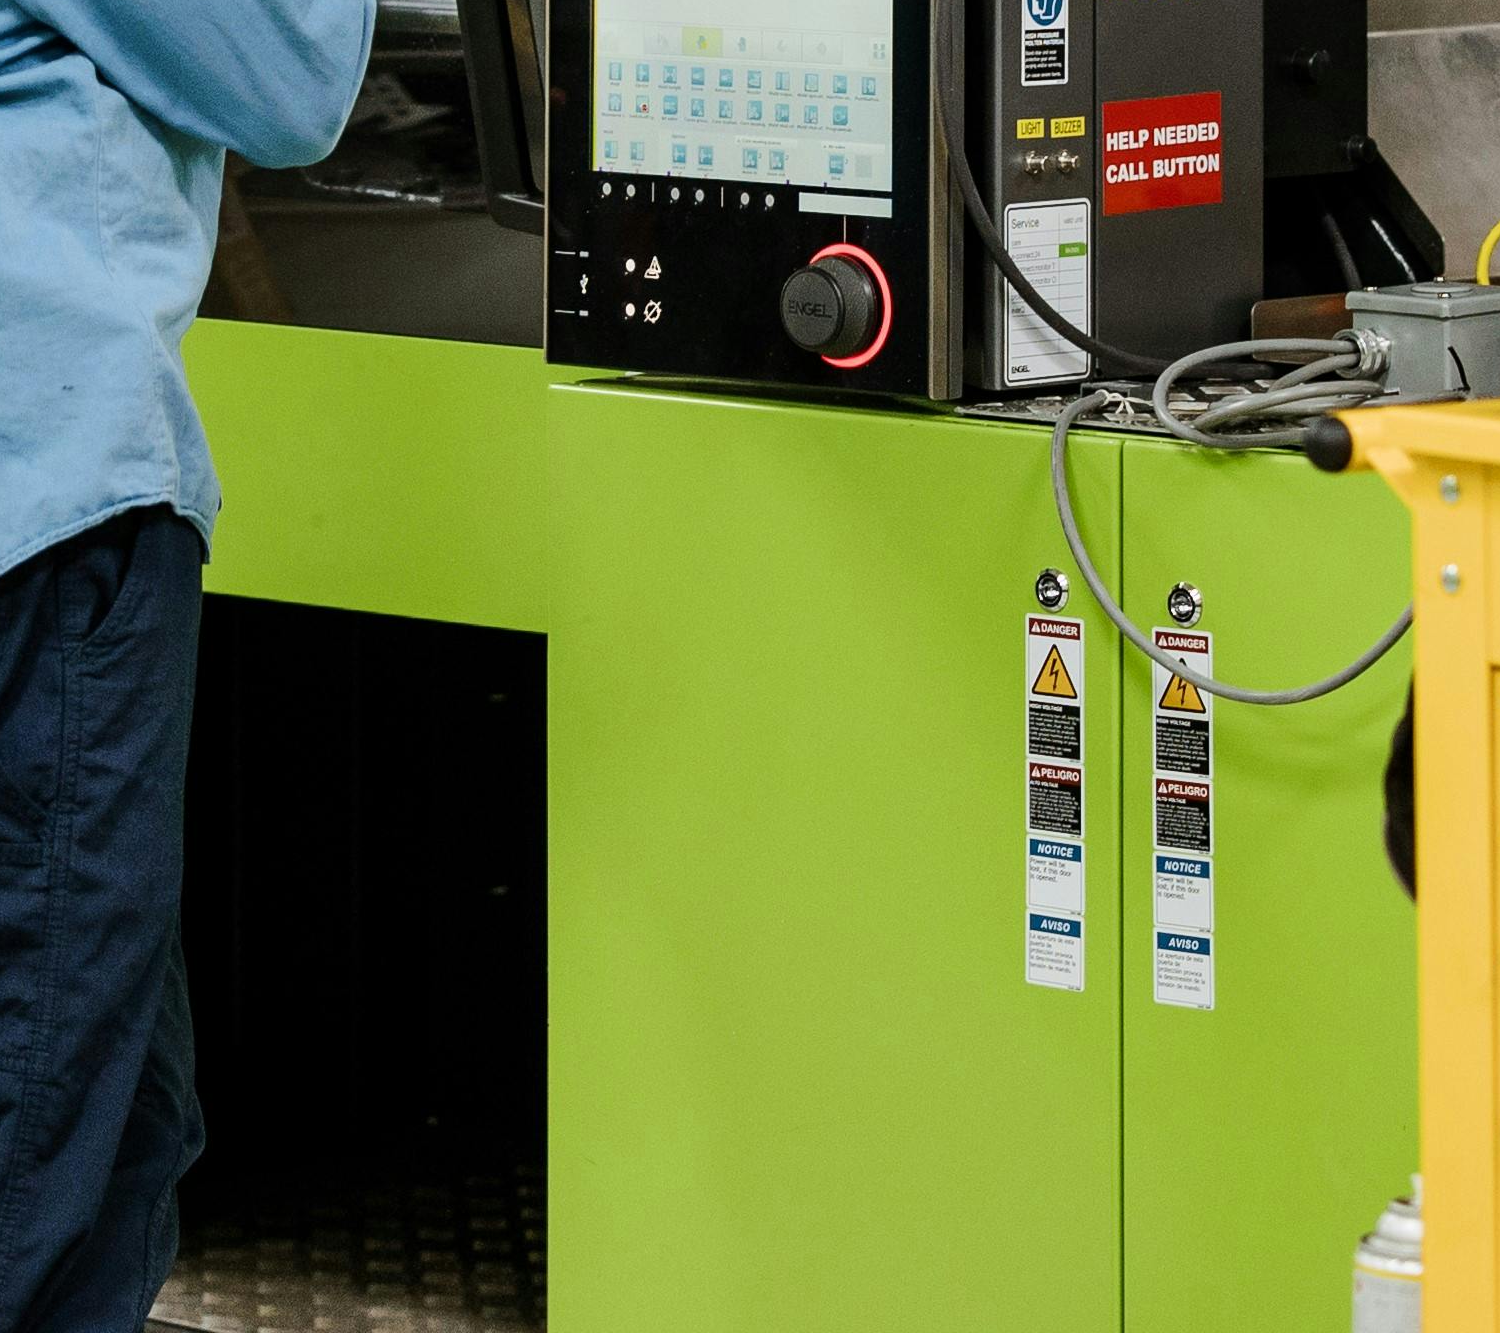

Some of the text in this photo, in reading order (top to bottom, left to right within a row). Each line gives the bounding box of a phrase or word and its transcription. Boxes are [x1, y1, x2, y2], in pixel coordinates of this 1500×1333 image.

[1021, 119, 1082, 135] LIGHT BUZZER
[1107, 122, 1219, 151] HELP NEEDED
[1106, 154, 1220, 183] CALL BUTTON
[1011, 218, 1039, 229] Service
[787, 299, 832, 319] ENGEL
[1012, 365, 1030, 374] ENGEL
[1041, 623, 1078, 637] DANGER
[1168, 636, 1206, 650] DANGER
[1041, 768, 1079, 782] PELIGRO
[1168, 783, 1208, 797] PELIGRO
[1037, 843, 1074, 858] NOTICE
[1164, 861, 1201, 874] NOTICE
[1040, 920, 1070, 933] AVISO
[1168, 937, 1199, 950] AVISO
